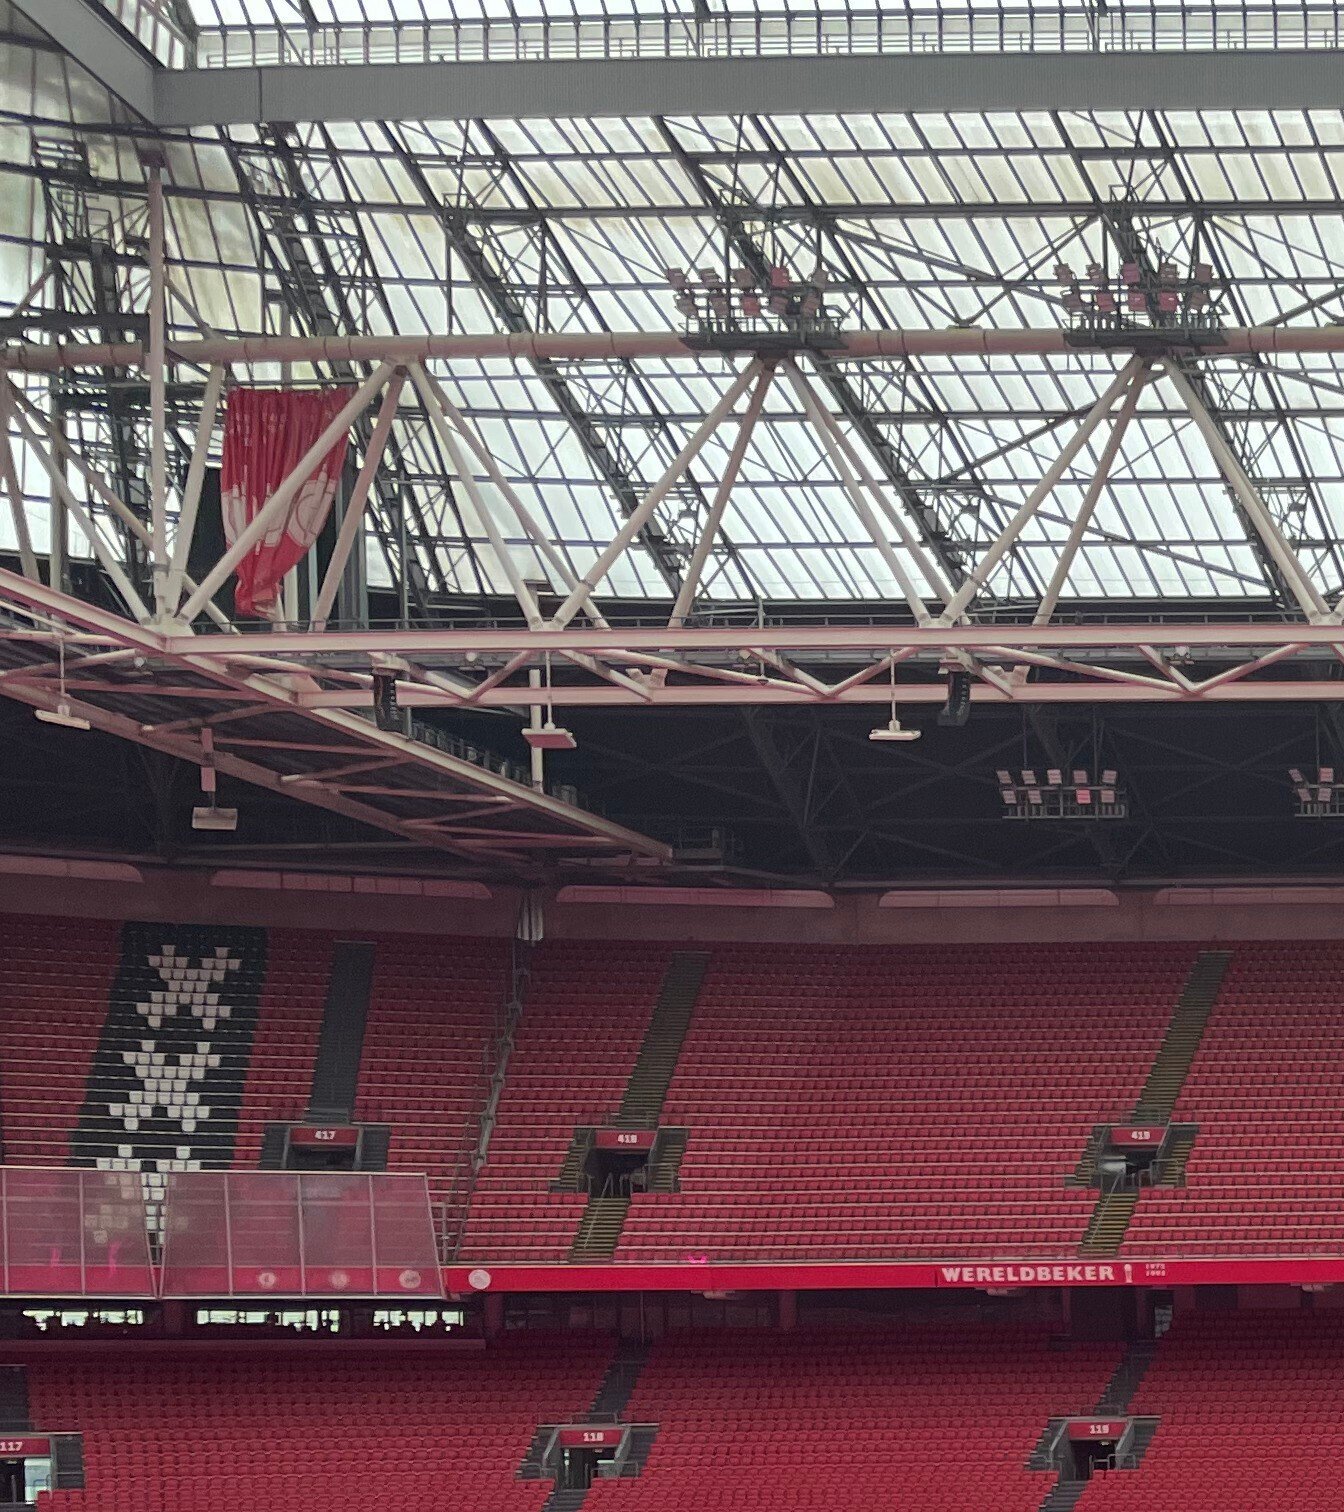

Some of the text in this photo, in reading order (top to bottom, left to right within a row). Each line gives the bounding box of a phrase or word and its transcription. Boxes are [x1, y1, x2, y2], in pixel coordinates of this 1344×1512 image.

[314, 1130, 336, 1140] 417
[941, 1265, 1115, 1282] WERELDBEKER
[0, 1441, 23, 1452] 117
